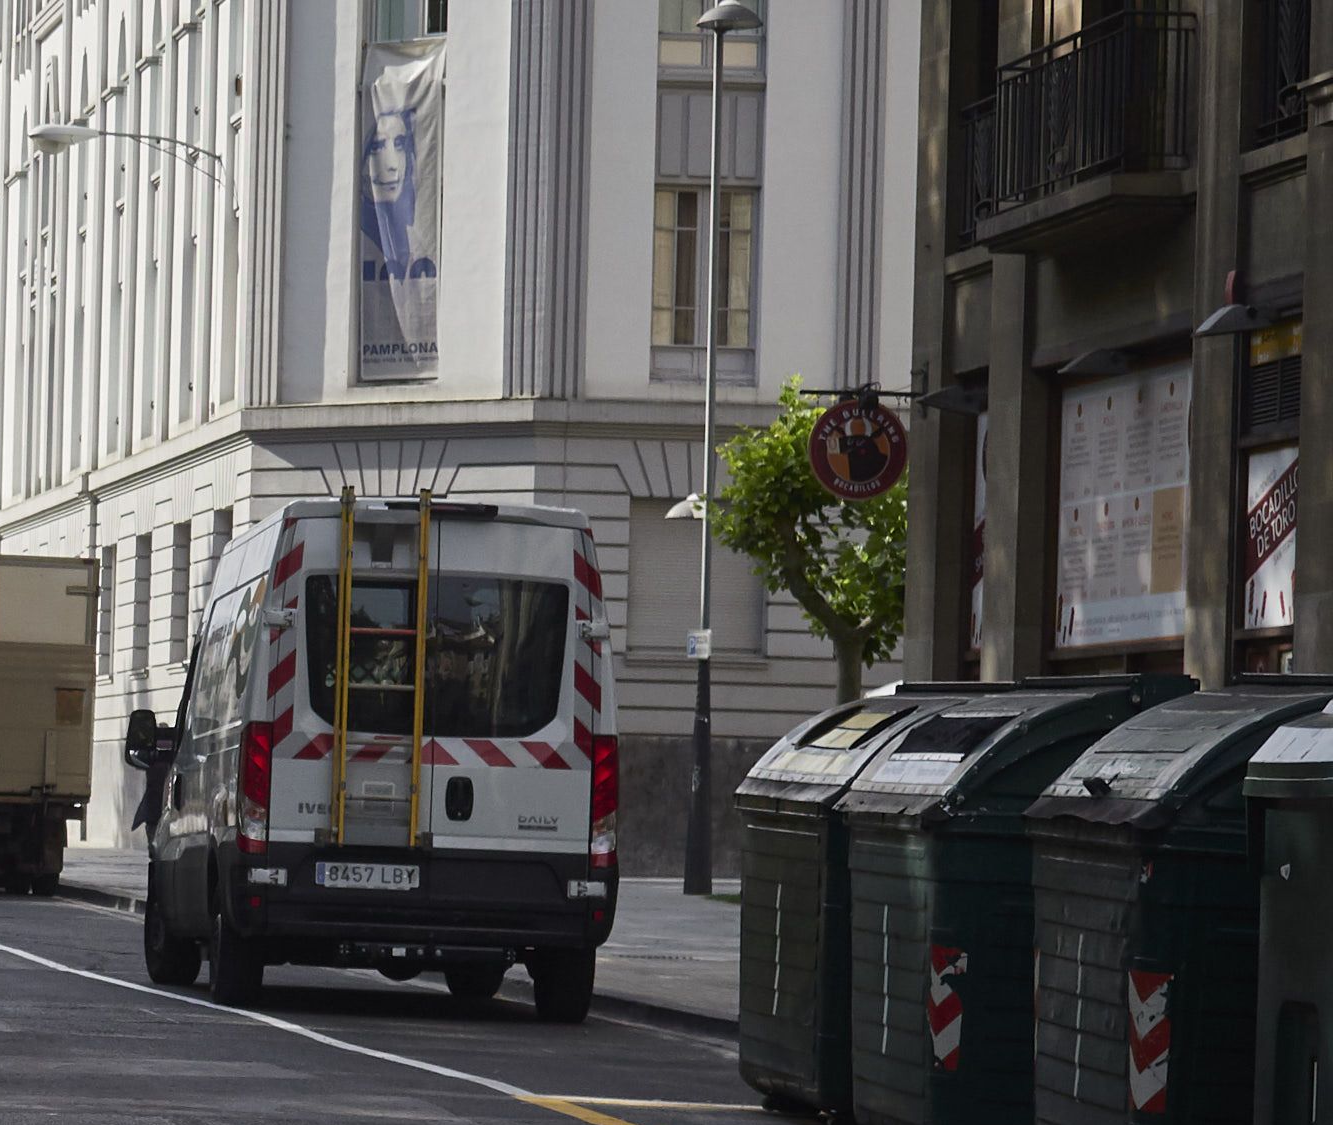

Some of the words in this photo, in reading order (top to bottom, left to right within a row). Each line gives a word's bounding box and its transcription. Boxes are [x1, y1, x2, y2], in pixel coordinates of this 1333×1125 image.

[362, 341, 439, 356] PAMPLONA
[833, 478, 881, 493] BOCADILLOS
[1256, 529, 1270, 558] DE
[1270, 500, 1296, 542] TORO
[328, 865, 374, 883] 8457
[380, 867, 416, 885] LBY
